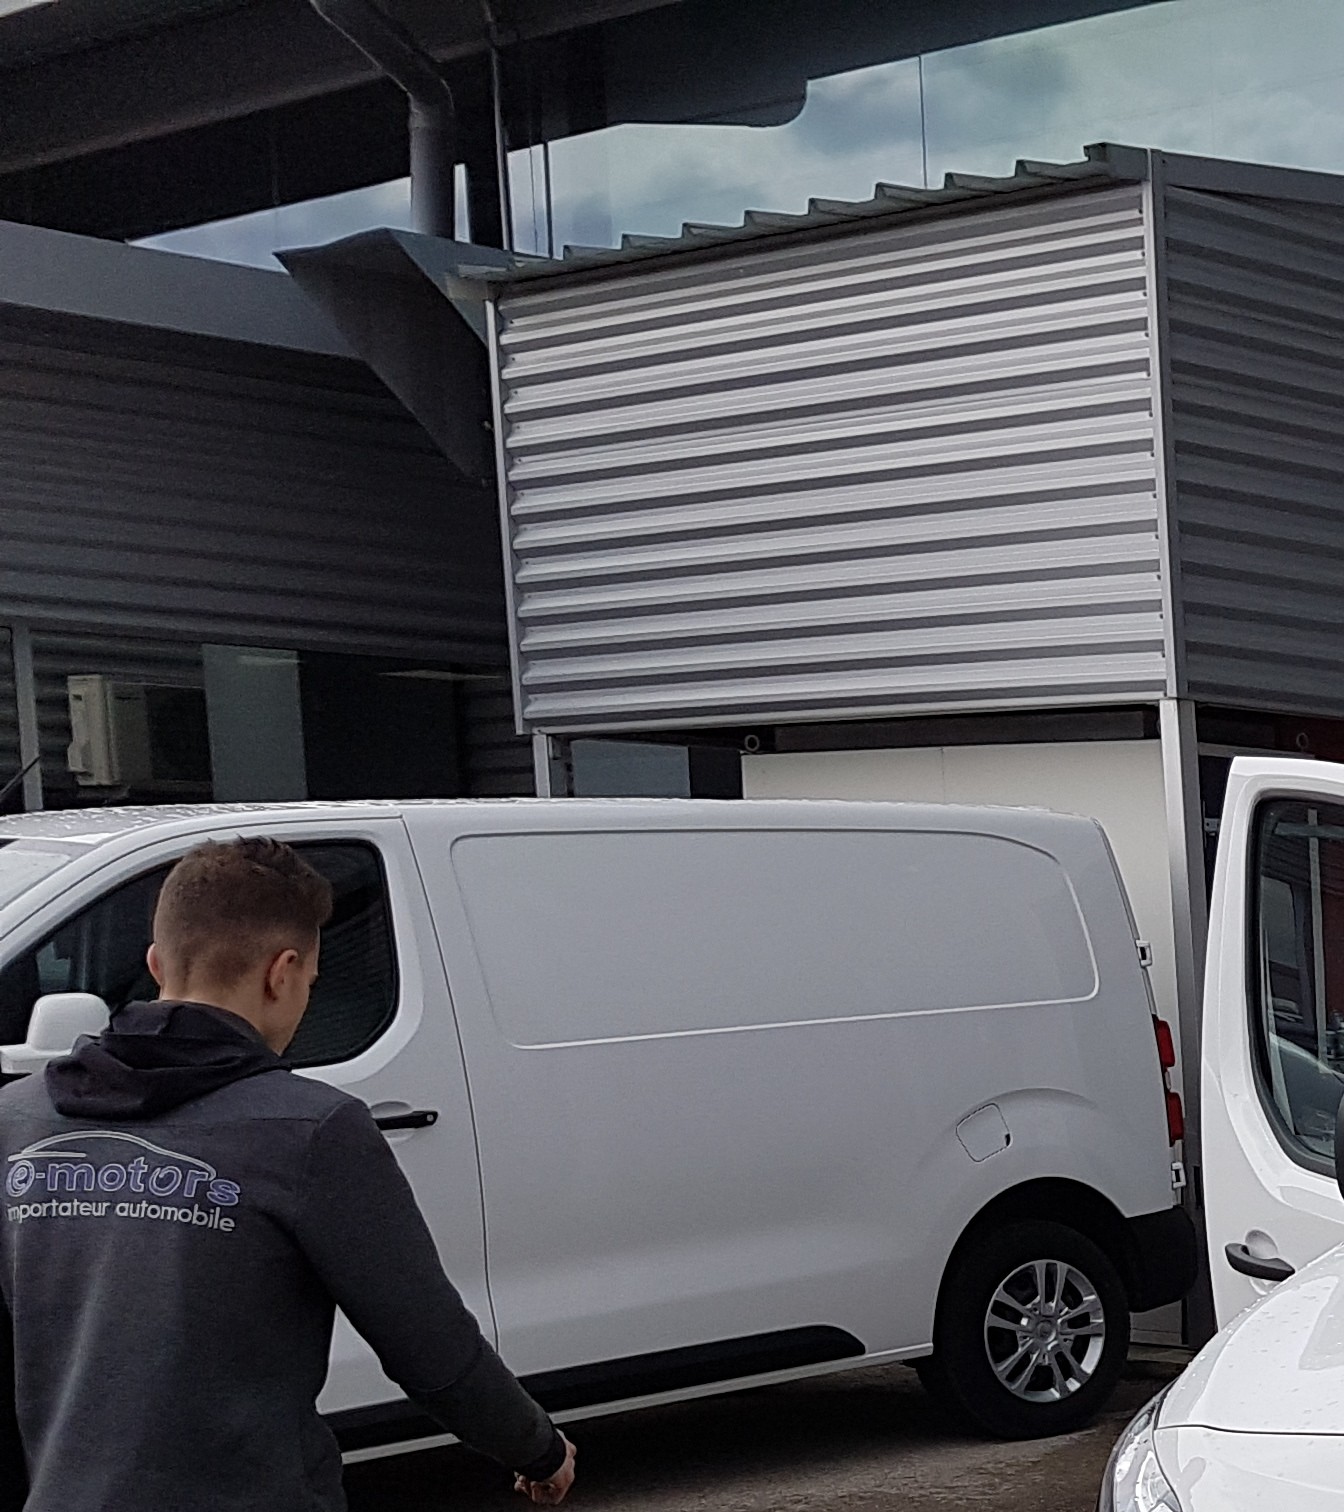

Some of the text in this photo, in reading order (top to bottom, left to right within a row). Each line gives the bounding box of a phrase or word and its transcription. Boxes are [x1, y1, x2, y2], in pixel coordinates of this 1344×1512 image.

[6, 1156, 241, 1206] e-motors
[7, 1199, 235, 1232] importateur automobile
